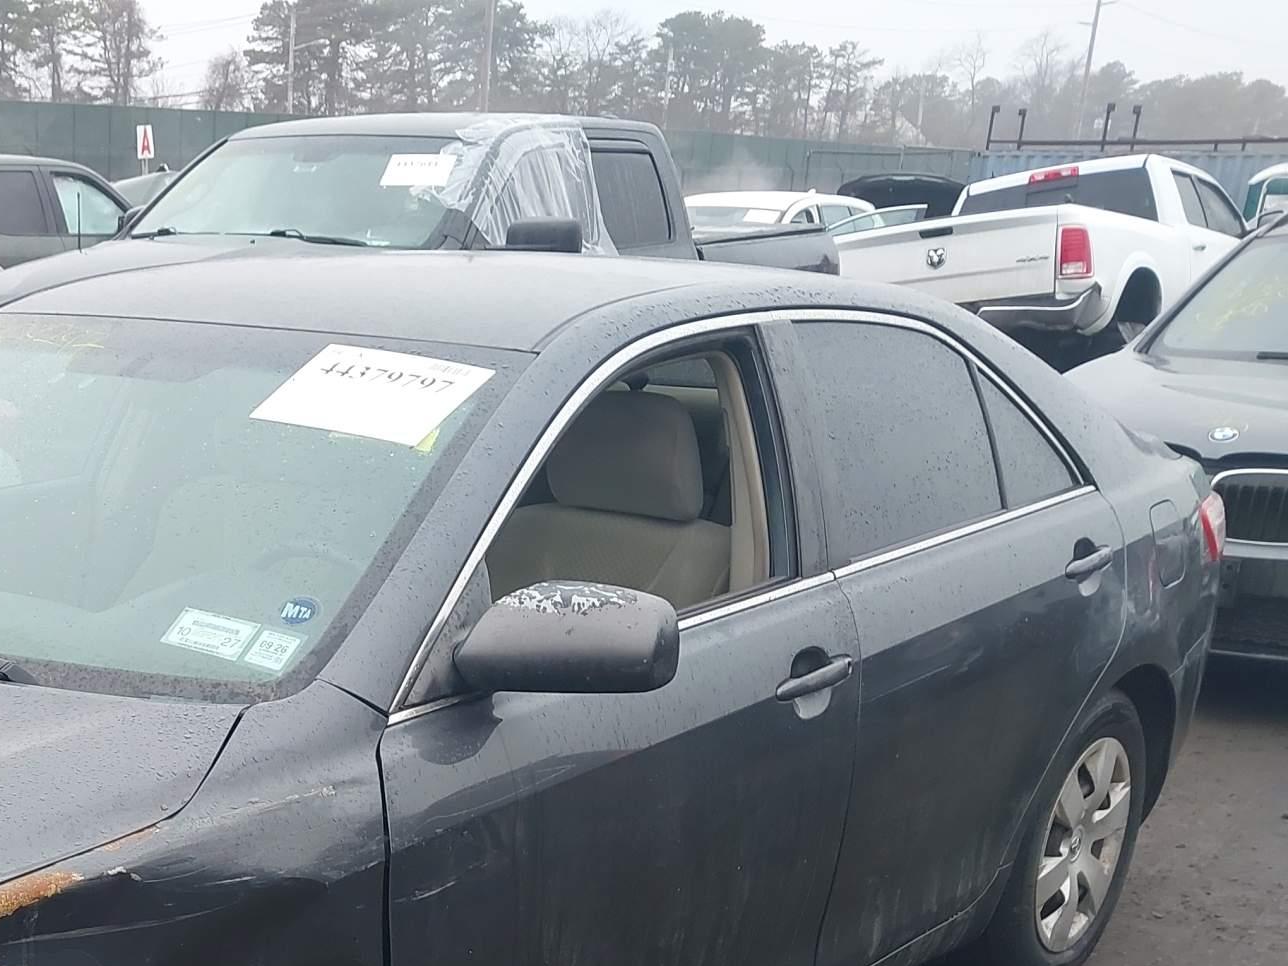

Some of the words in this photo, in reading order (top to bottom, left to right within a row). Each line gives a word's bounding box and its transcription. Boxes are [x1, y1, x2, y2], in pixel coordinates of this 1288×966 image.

[141, 127, 152, 156] A
[320, 362, 455, 392] 44379797
[280, 602, 312, 619] MTA
